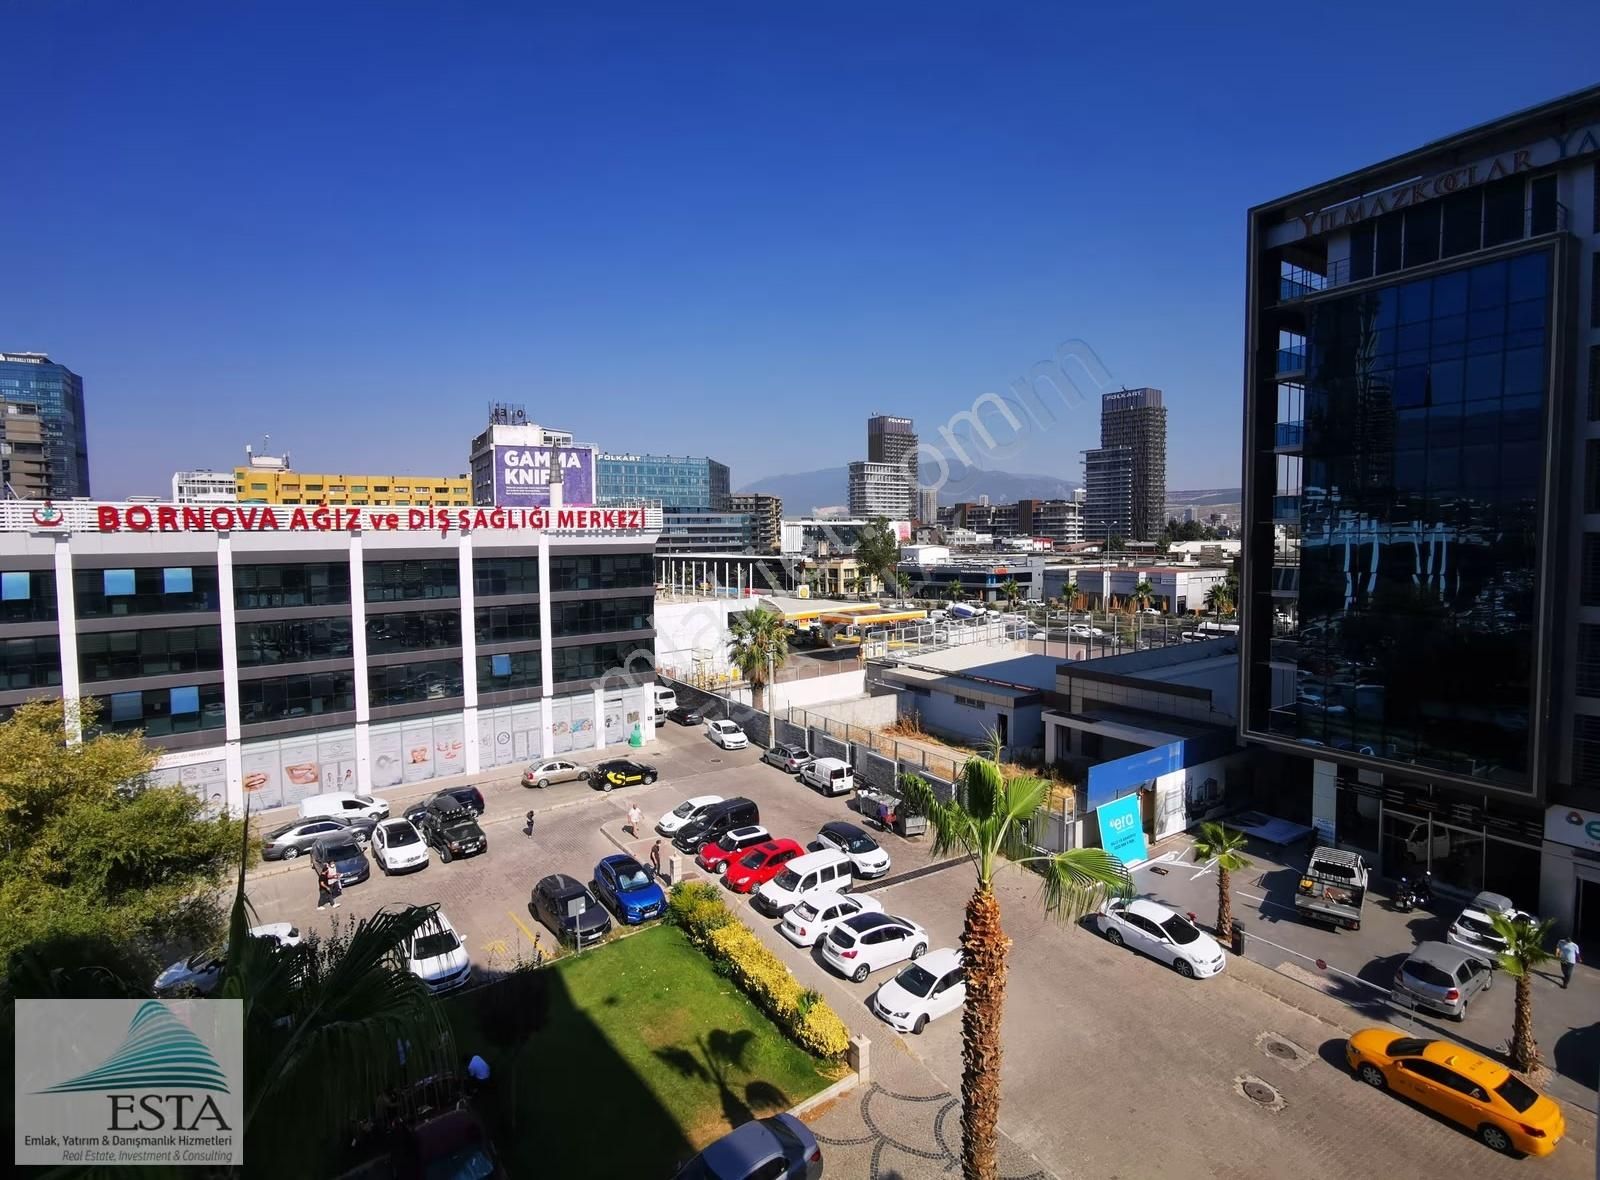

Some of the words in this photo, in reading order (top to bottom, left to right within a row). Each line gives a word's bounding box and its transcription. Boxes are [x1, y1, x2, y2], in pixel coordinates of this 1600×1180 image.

[598, 454, 641, 462] FOLKART
[504, 468, 565, 486] KNIF
[97, 505, 279, 533] BORNOVA
[289, 502, 361, 531] AĞIZ
[369, 512, 399, 530] ve
[408, 504, 450, 532] DİŞ
[458, 505, 550, 530] SAĞLIĞI
[557, 506, 646, 530] MERKEZİ
